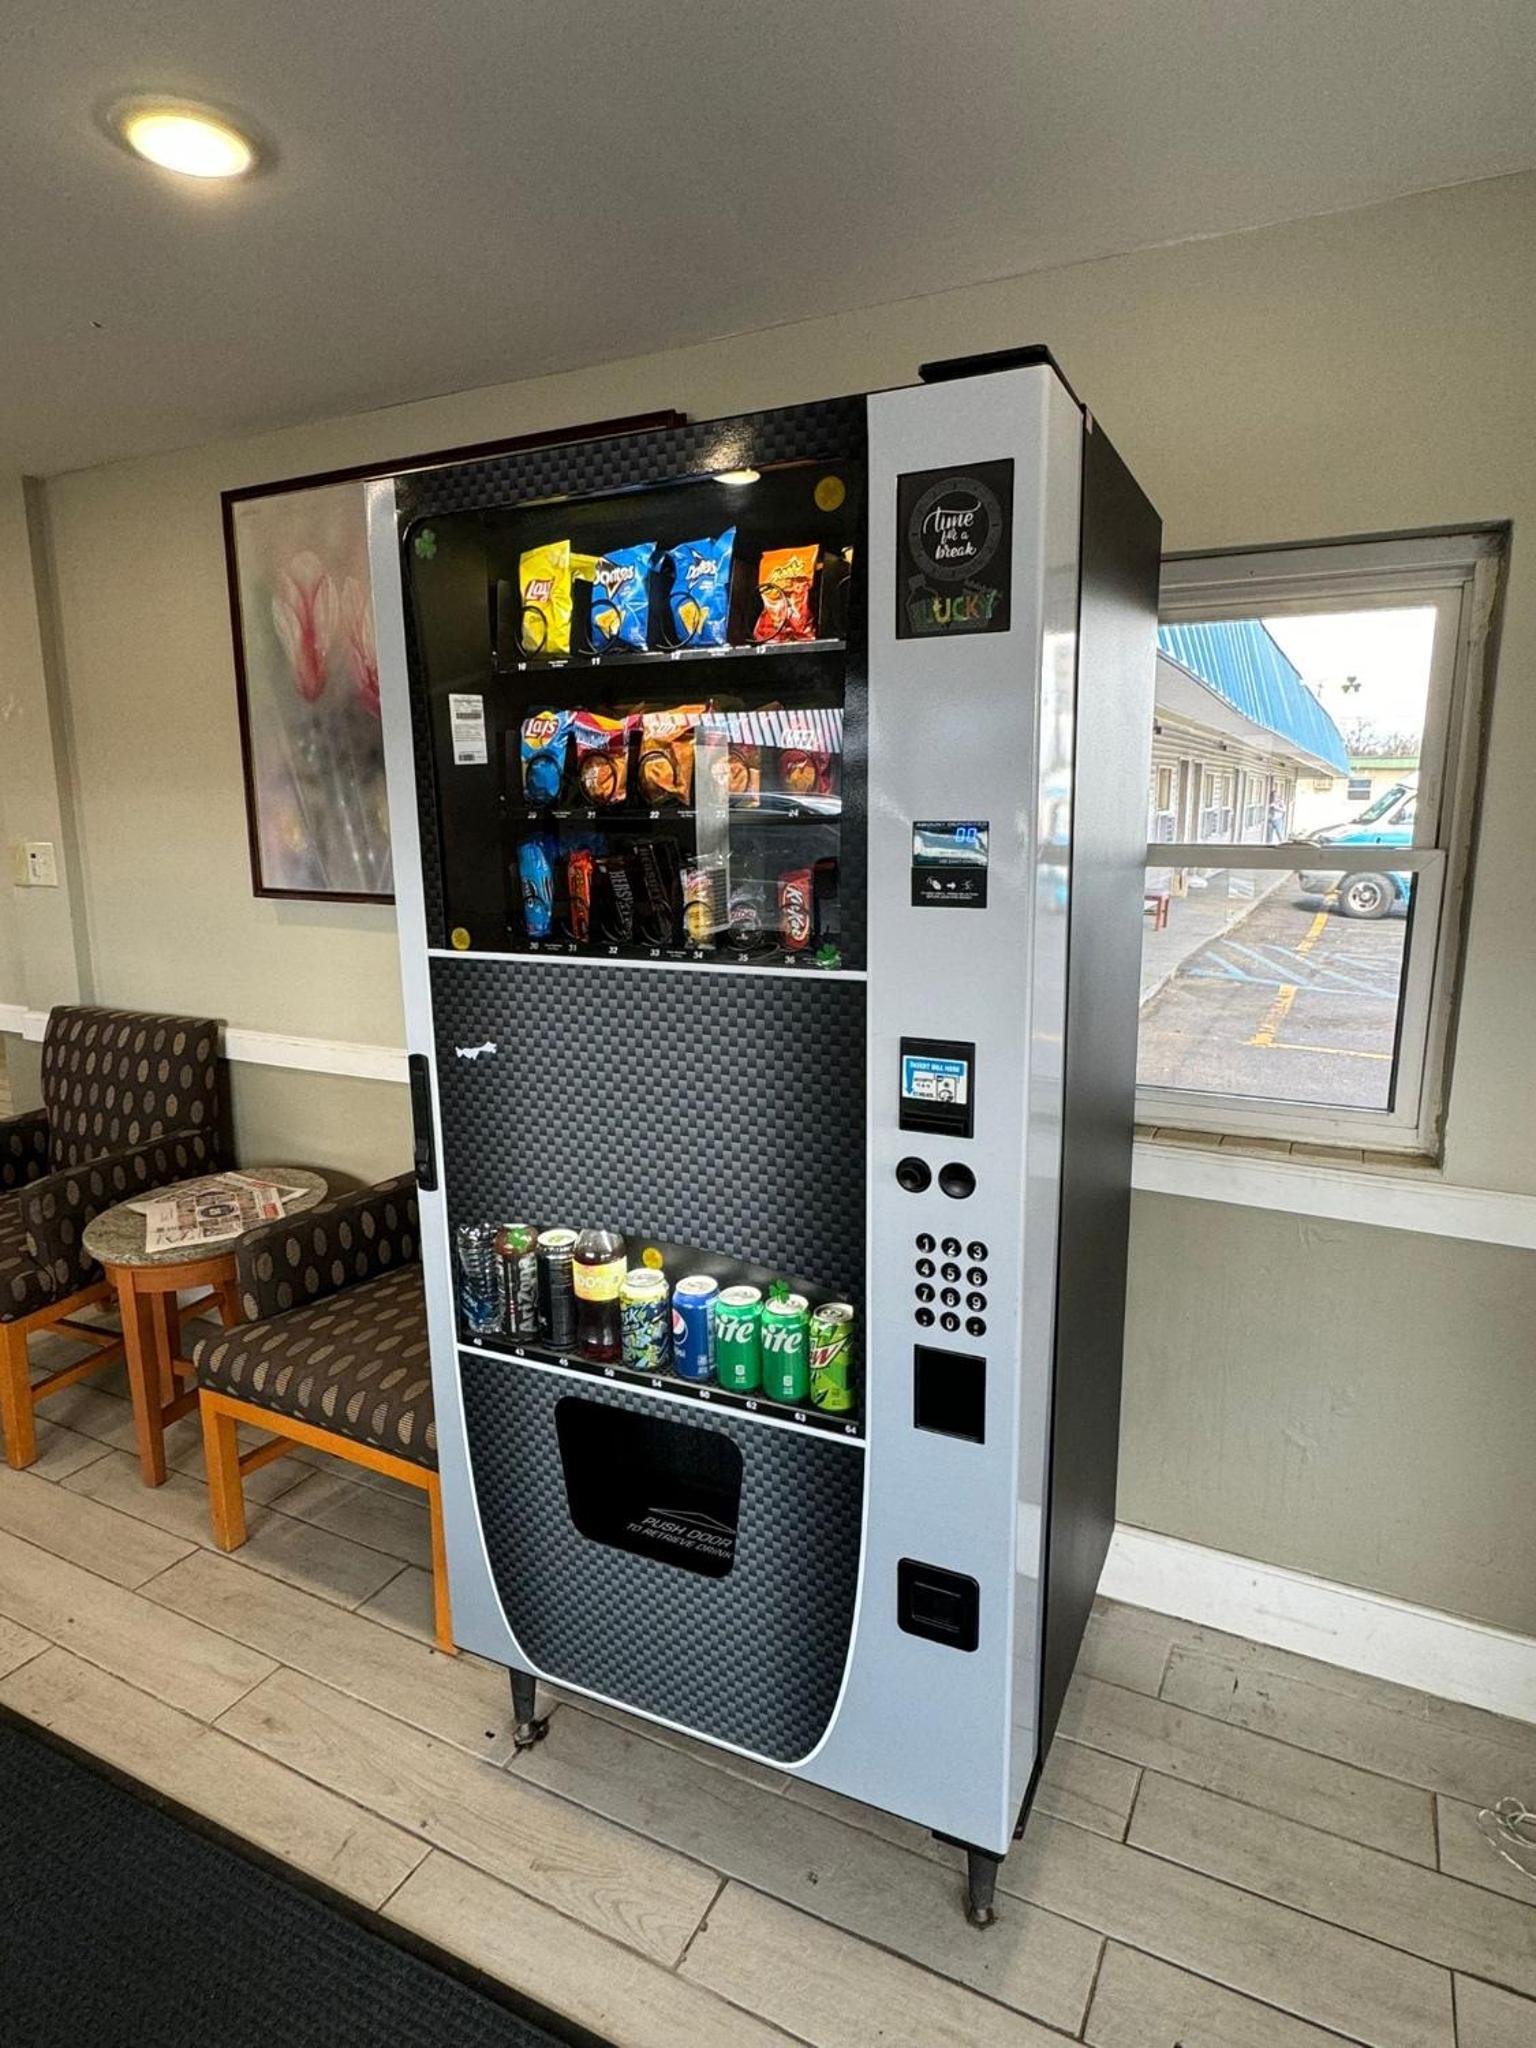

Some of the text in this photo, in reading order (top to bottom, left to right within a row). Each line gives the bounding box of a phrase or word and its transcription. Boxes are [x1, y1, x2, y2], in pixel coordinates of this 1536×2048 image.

[923, 501, 981, 534] time
[934, 542, 977, 561] break
[922, 1238, 982, 1258] 1 2 3
[921, 1263, 982, 1284] 4 5 6
[921, 1288, 981, 1309] 7 8 9
[946, 1317, 954, 1329] 0
[746, 1401, 757, 1410] 62
[794, 1413, 806, 1422] 63
[845, 1425, 857, 1435] 64
[626, 1523, 734, 1559] TO RETRIEVE DRINK
[641, 1516, 733, 1547] PUSH DOOR
